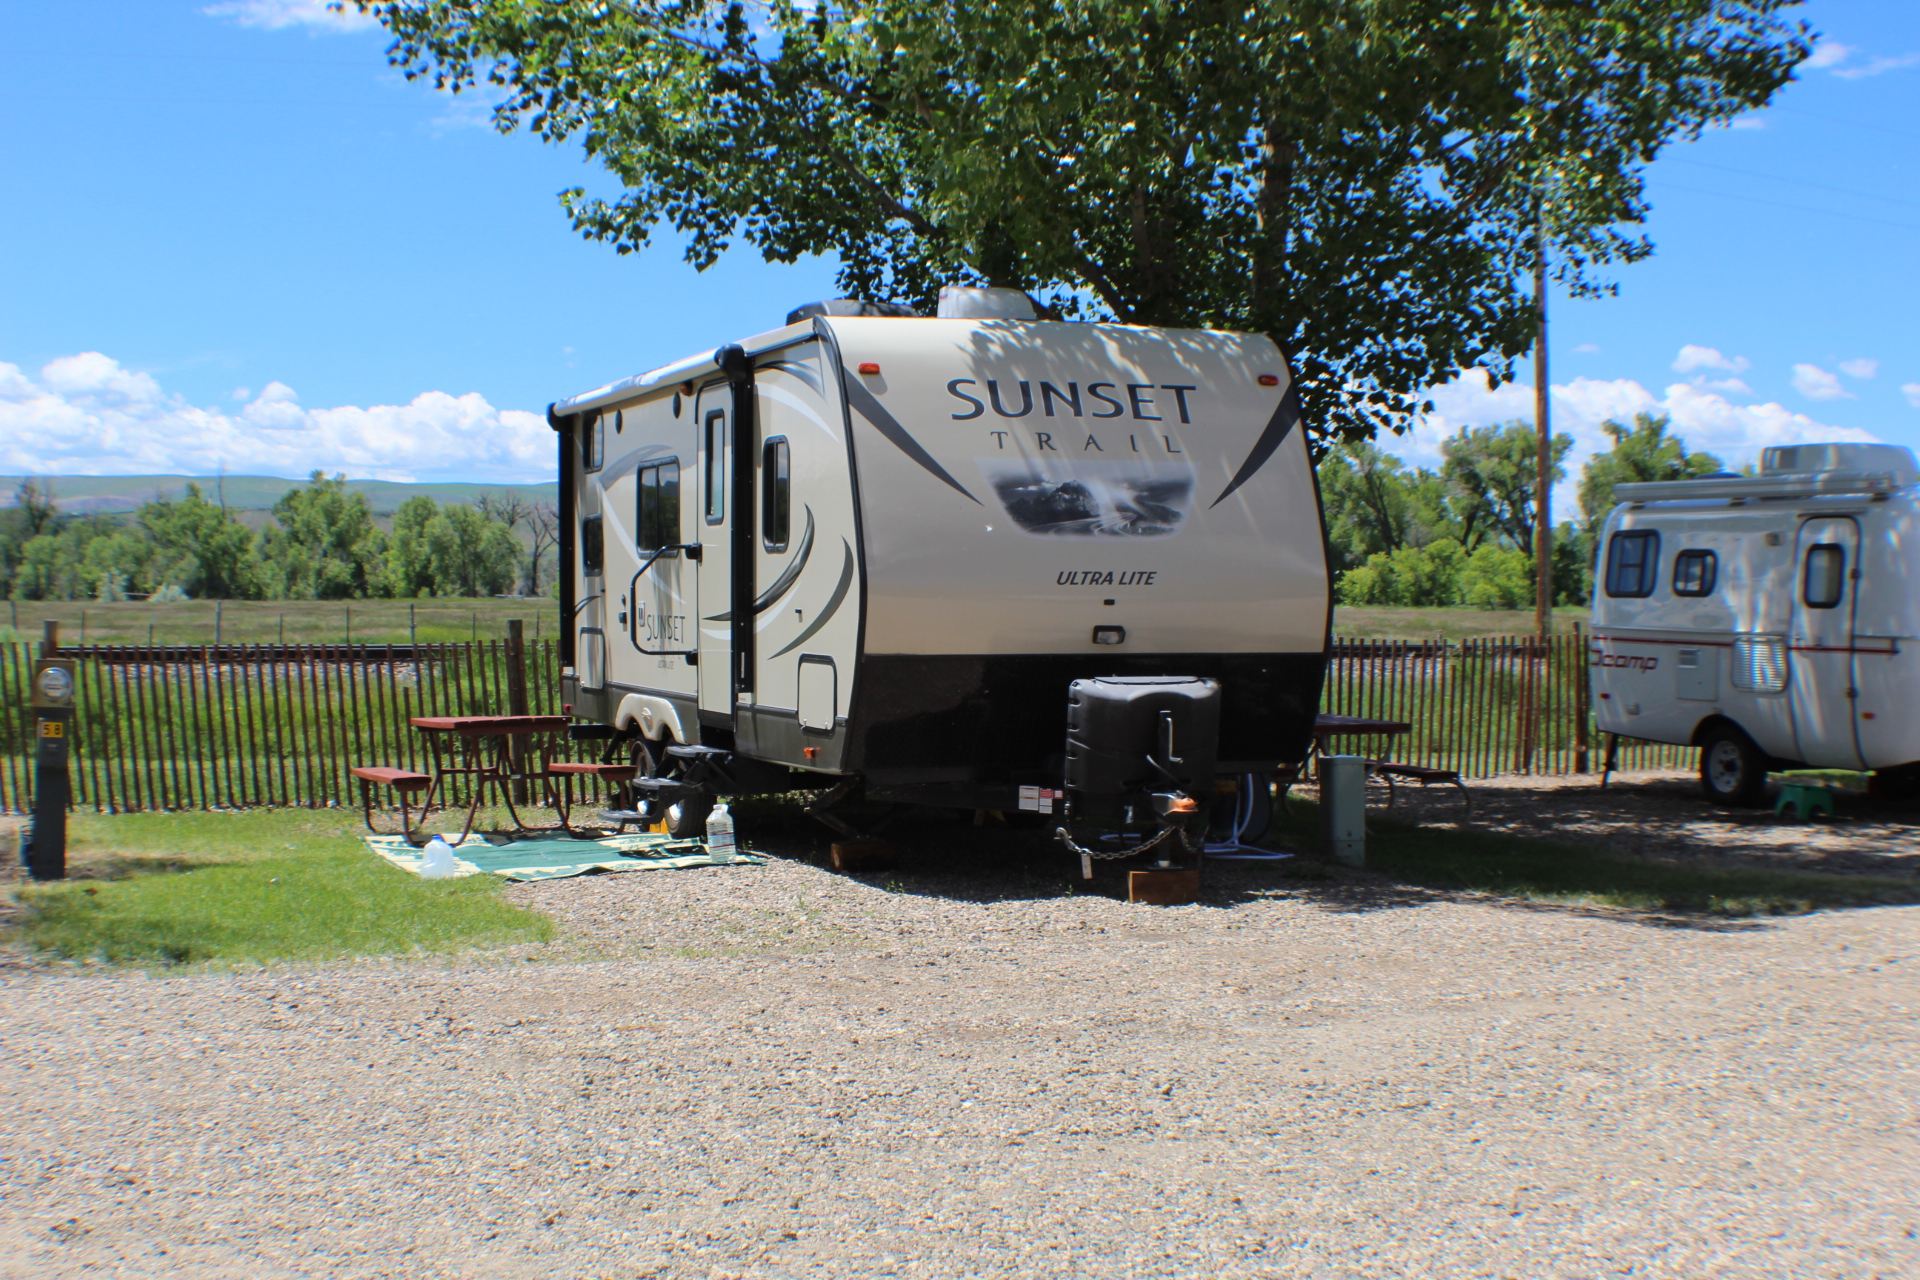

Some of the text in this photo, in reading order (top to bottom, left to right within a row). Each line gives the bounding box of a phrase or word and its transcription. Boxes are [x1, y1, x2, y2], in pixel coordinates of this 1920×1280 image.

[947, 378, 1197, 425] SUNSET
[990, 431, 1181, 453] TRAIL
[1056, 571, 1157, 585] ULTRA LITE
[646, 614, 686, 644] SUNSET
